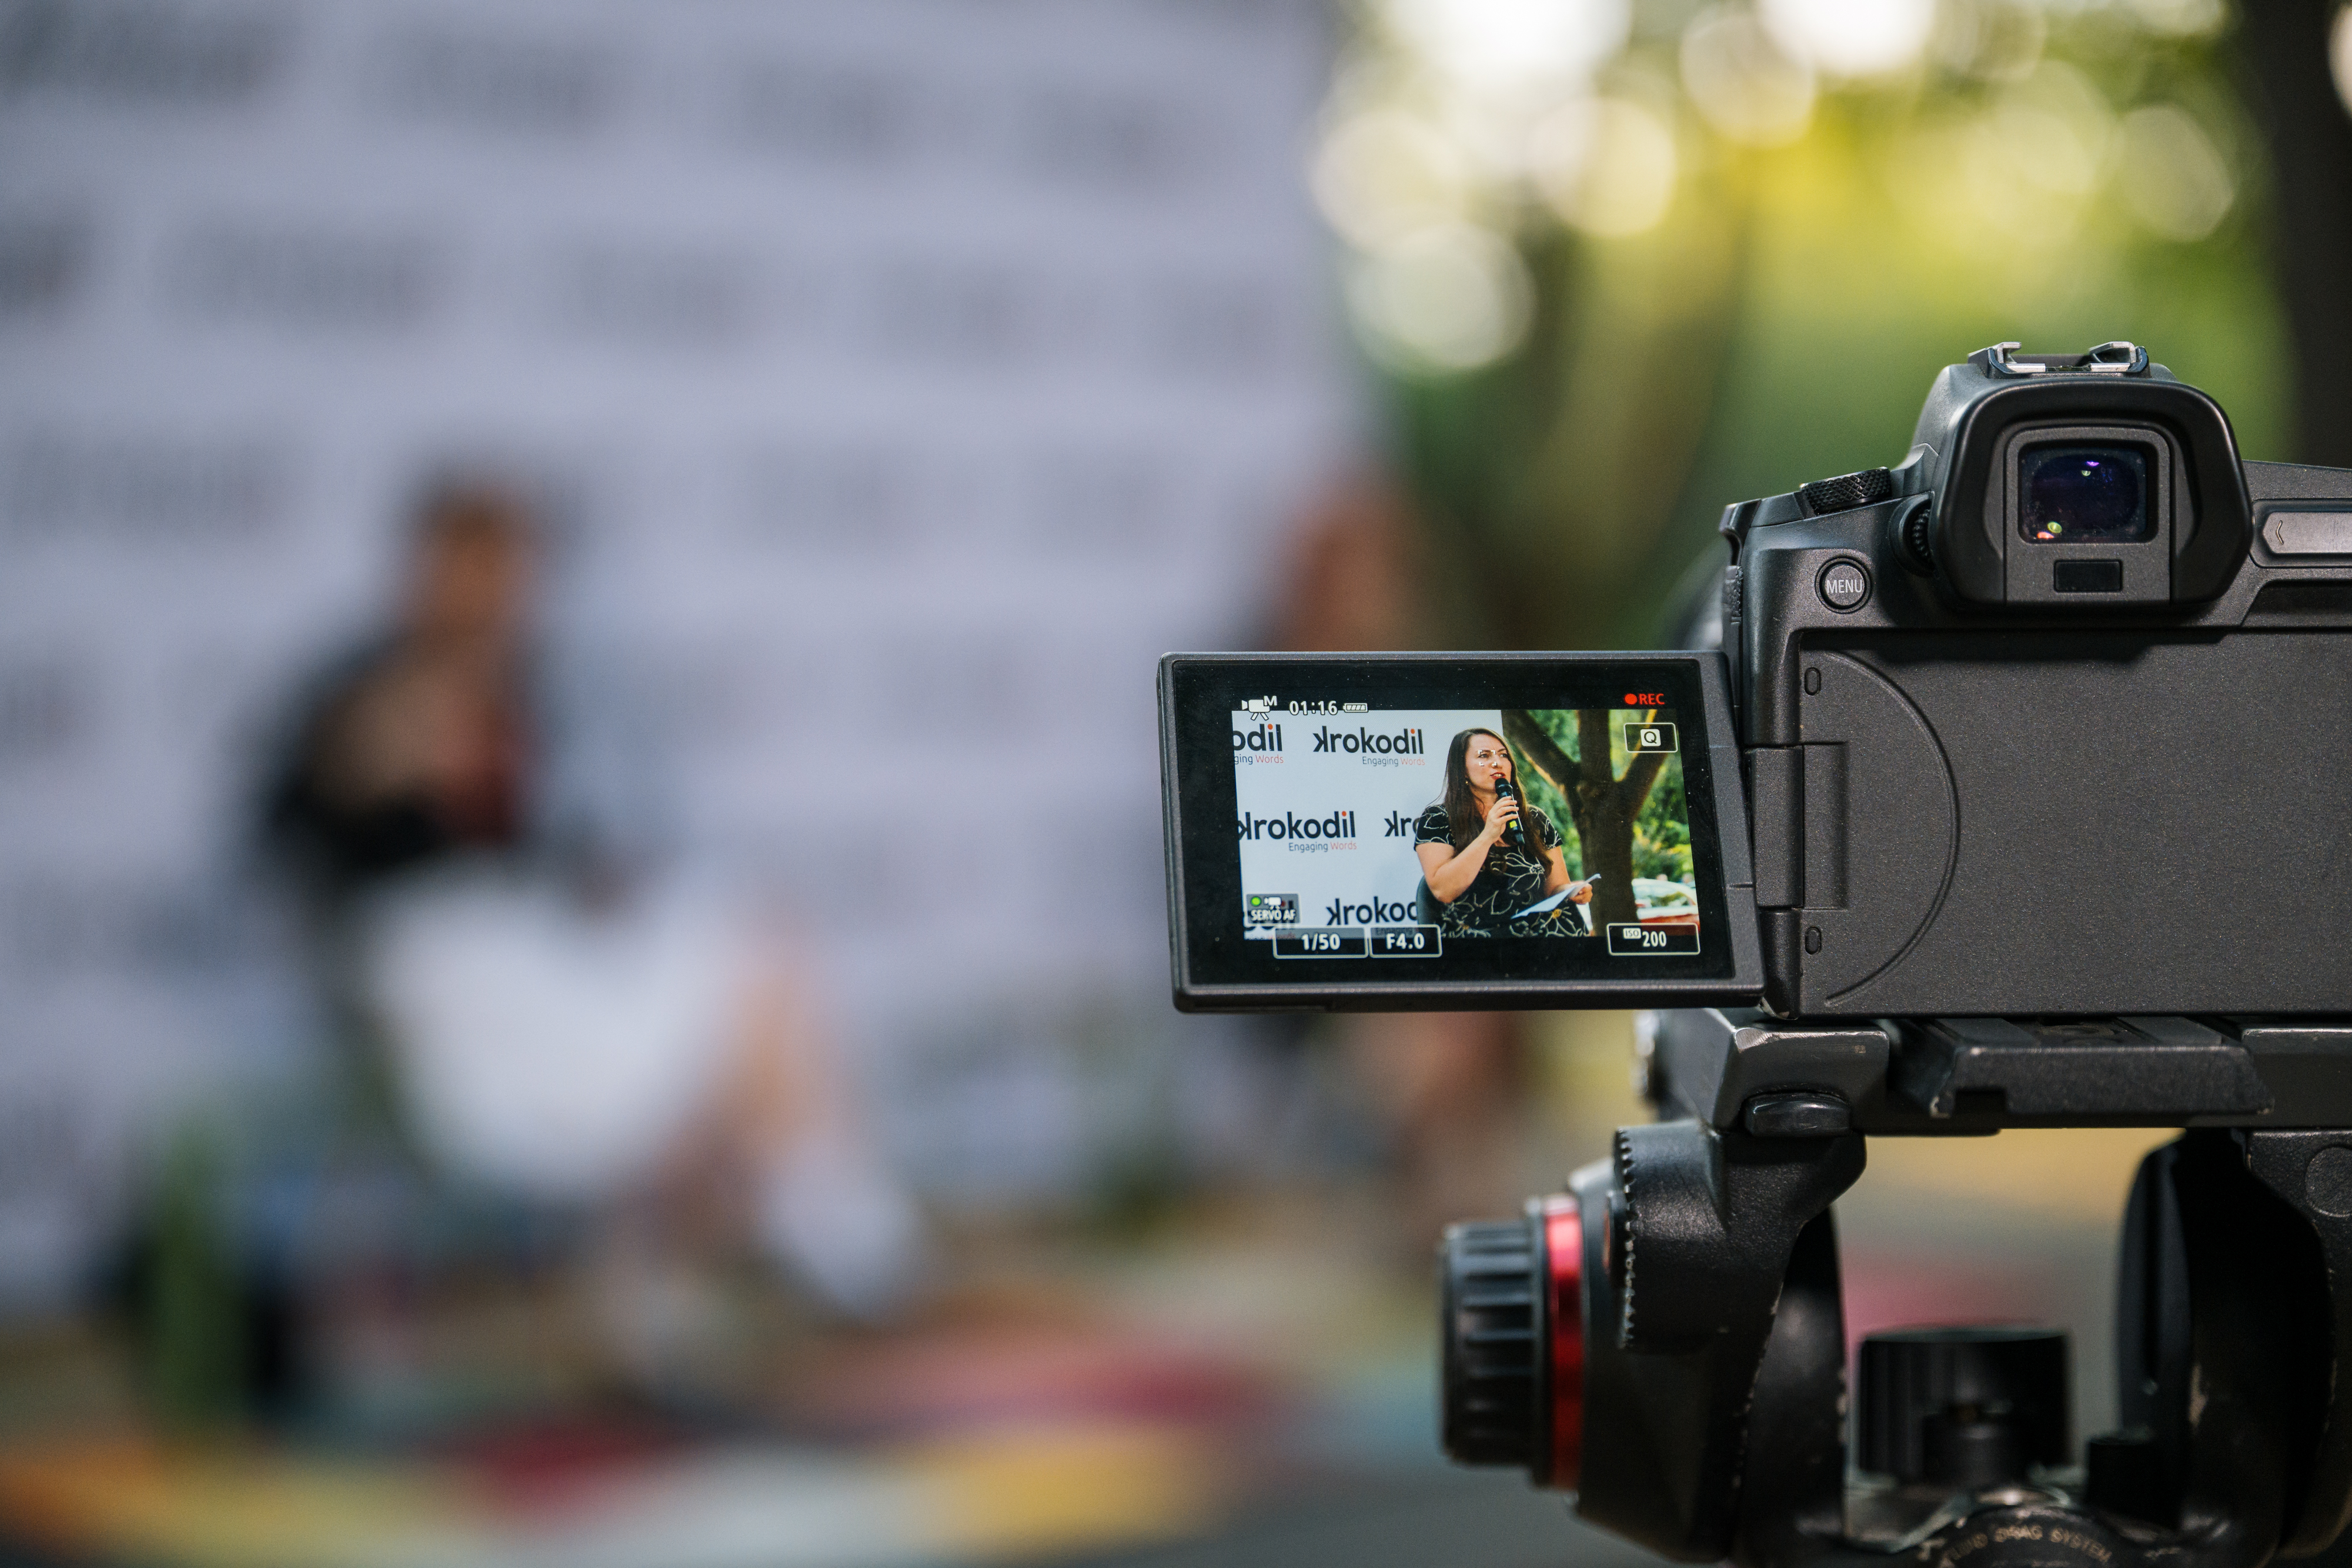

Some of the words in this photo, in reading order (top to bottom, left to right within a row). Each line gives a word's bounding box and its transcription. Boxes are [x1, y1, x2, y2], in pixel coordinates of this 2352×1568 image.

[1826, 579, 1862, 593] MENU
[1264, 696, 1277, 706] M
[1639, 693, 1665, 705] REC
[1289, 701, 1338, 716] 01:16
[1313, 726, 1424, 754] krokodil
[1644, 731, 1657, 744] Q
[1255, 754, 1284, 764] Words
[1362, 756, 1399, 767] Engaging
[1400, 757, 1426, 766] Words
[1289, 842, 1328, 853] Engaging
[1331, 841, 1358, 851] Words
[1251, 910, 1281, 921] SERVO
[1283, 910, 1296, 921] AF
[1301, 934, 1341, 951] 1/50
[1386, 933, 1425, 950] F4.0
[1642, 931, 1666, 947] 200
